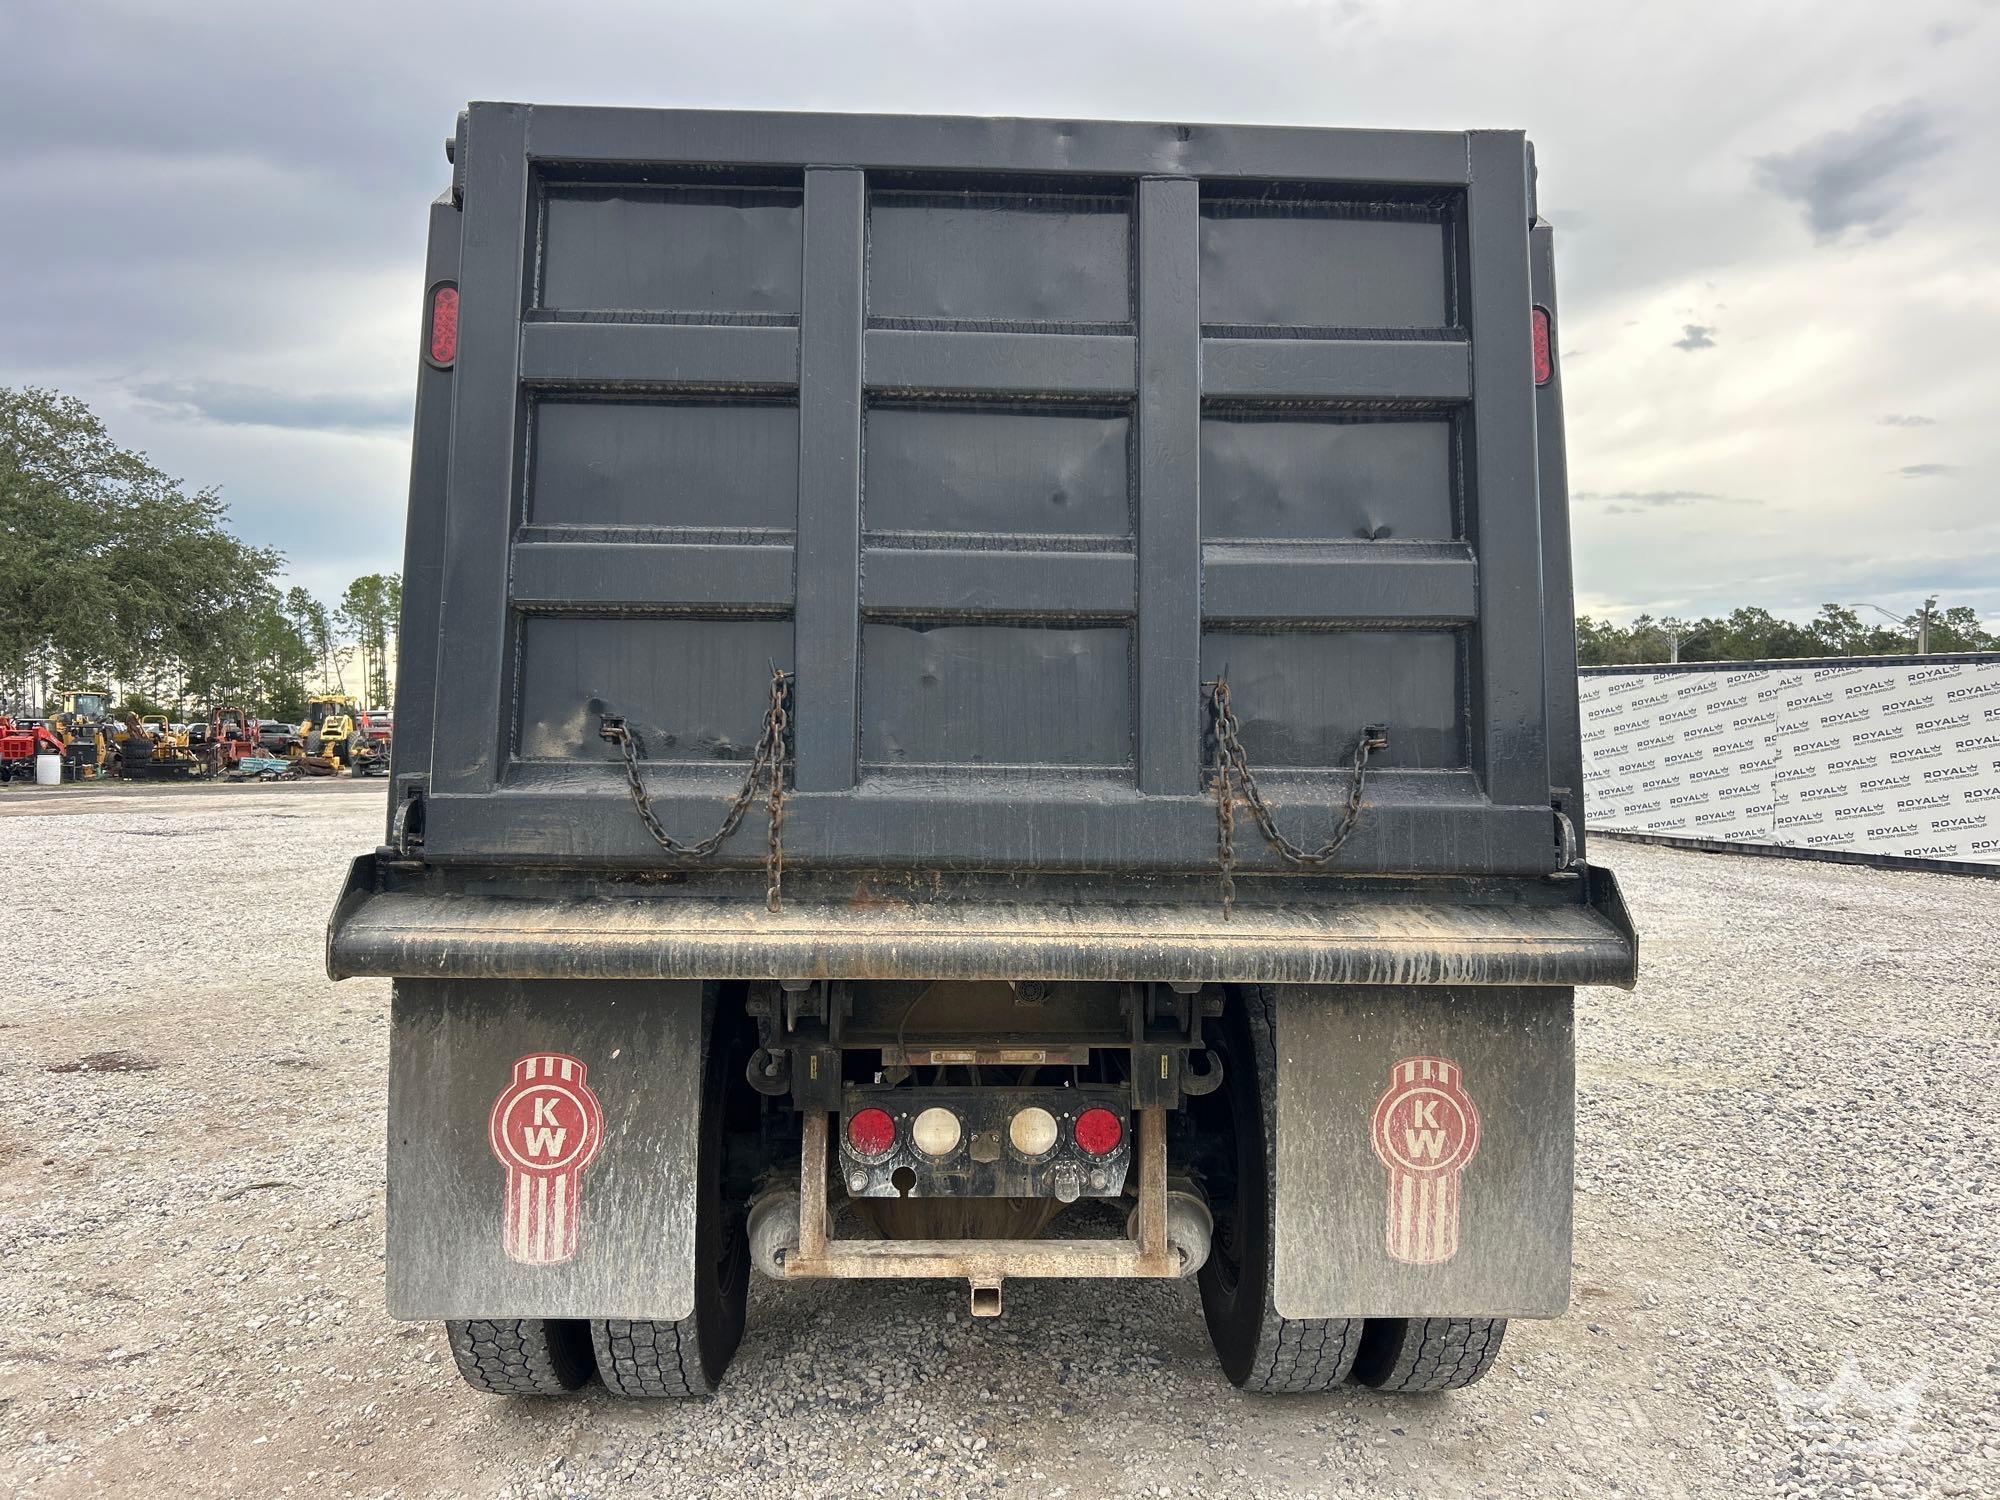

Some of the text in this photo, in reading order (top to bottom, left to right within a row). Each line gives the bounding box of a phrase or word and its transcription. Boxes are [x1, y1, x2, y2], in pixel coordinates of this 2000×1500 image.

[1653, 673, 1682, 681] ROY
[1727, 671, 1760, 683] ROYAL
[1908, 668, 1949, 681] ROYAL
[1608, 681, 1636, 692] ROYAL
[1678, 684, 1708, 696] ROYAL
[1845, 682, 1884, 694] ROYAL
[1948, 685, 1991, 698] ROYAL
[1580, 691, 1593, 700] YAL
[1758, 689, 1778, 698] ROY
[1632, 696, 1660, 707] ROYAL
[1707, 699, 1739, 710] ROYAL
[1787, 694, 1823, 707] ROYAL
[1882, 699, 1922, 711] ROYAL
[1589, 707, 1615, 718] ROYAL
[1659, 711, 1688, 721] ROYAL
[1820, 712, 1859, 723] ROYAL
[1733, 715, 1766, 726] ROYAL
[1916, 717, 1958, 730] ROYAL
[1614, 722, 1642, 731] ROYAL
[1776, 722, 1799, 732] YAL
[1582, 730, 1598, 739] YAL
[1684, 728, 1714, 738] ROYAL
[1853, 730, 1892, 741] ROYAL
[1637, 737, 1666, 747] ROYAL
[1794, 741, 1830, 752] ROYAL
[1956, 736, 1999, 748] ROYAL
[1594, 747, 1620, 756] ROYAL
[1713, 743, 1744, 753] ROYAL
[1665, 753, 1694, 763] ROYAL
[1890, 748, 1930, 759] ROYAL
[1619, 762, 1647, 771] ROYAL
[1740, 760, 1773, 770] ROYAL
[1828, 759, 1866, 770] ROYAL
[1583, 771, 1602, 779] OYAL
[1690, 769, 1720, 779] ROYAL
[1775, 768, 1806, 778] OYAL
[1924, 767, 1966, 779] ROYAL
[1643, 778, 1672, 788] ROYAL
[1860, 776, 1899, 788] ROYAL
[1599, 787, 1626, 796] ROYAL
[1719, 786, 1751, 796] ROYAL
[1800, 787, 1837, 798] ROYAL
[1964, 787, 2000, 798] ROYA
[1670, 794, 1700, 804] ROYAL
[1898, 796, 1938, 807] ROYAL
[1624, 802, 1653, 811] ROYAL
[1746, 805, 1774, 814] ROYA
[1835, 806, 1874, 816] ROYAL
[1585, 810, 1608, 818] OYAL
[1696, 812, 1727, 821] ROYAL
[1778, 814, 1813, 824] ROYAL
[1648, 820, 1677, 828] ROYAL
[1931, 818, 1975, 828] ROYAL
[1725, 830, 1756, 839] ROYAL
[1867, 826, 1907, 836] ROYAL
[1808, 833, 1844, 843] ROYAL
[1972, 840, 1998, 849] ROY
[1904, 847, 1945, 856] ROYAL
